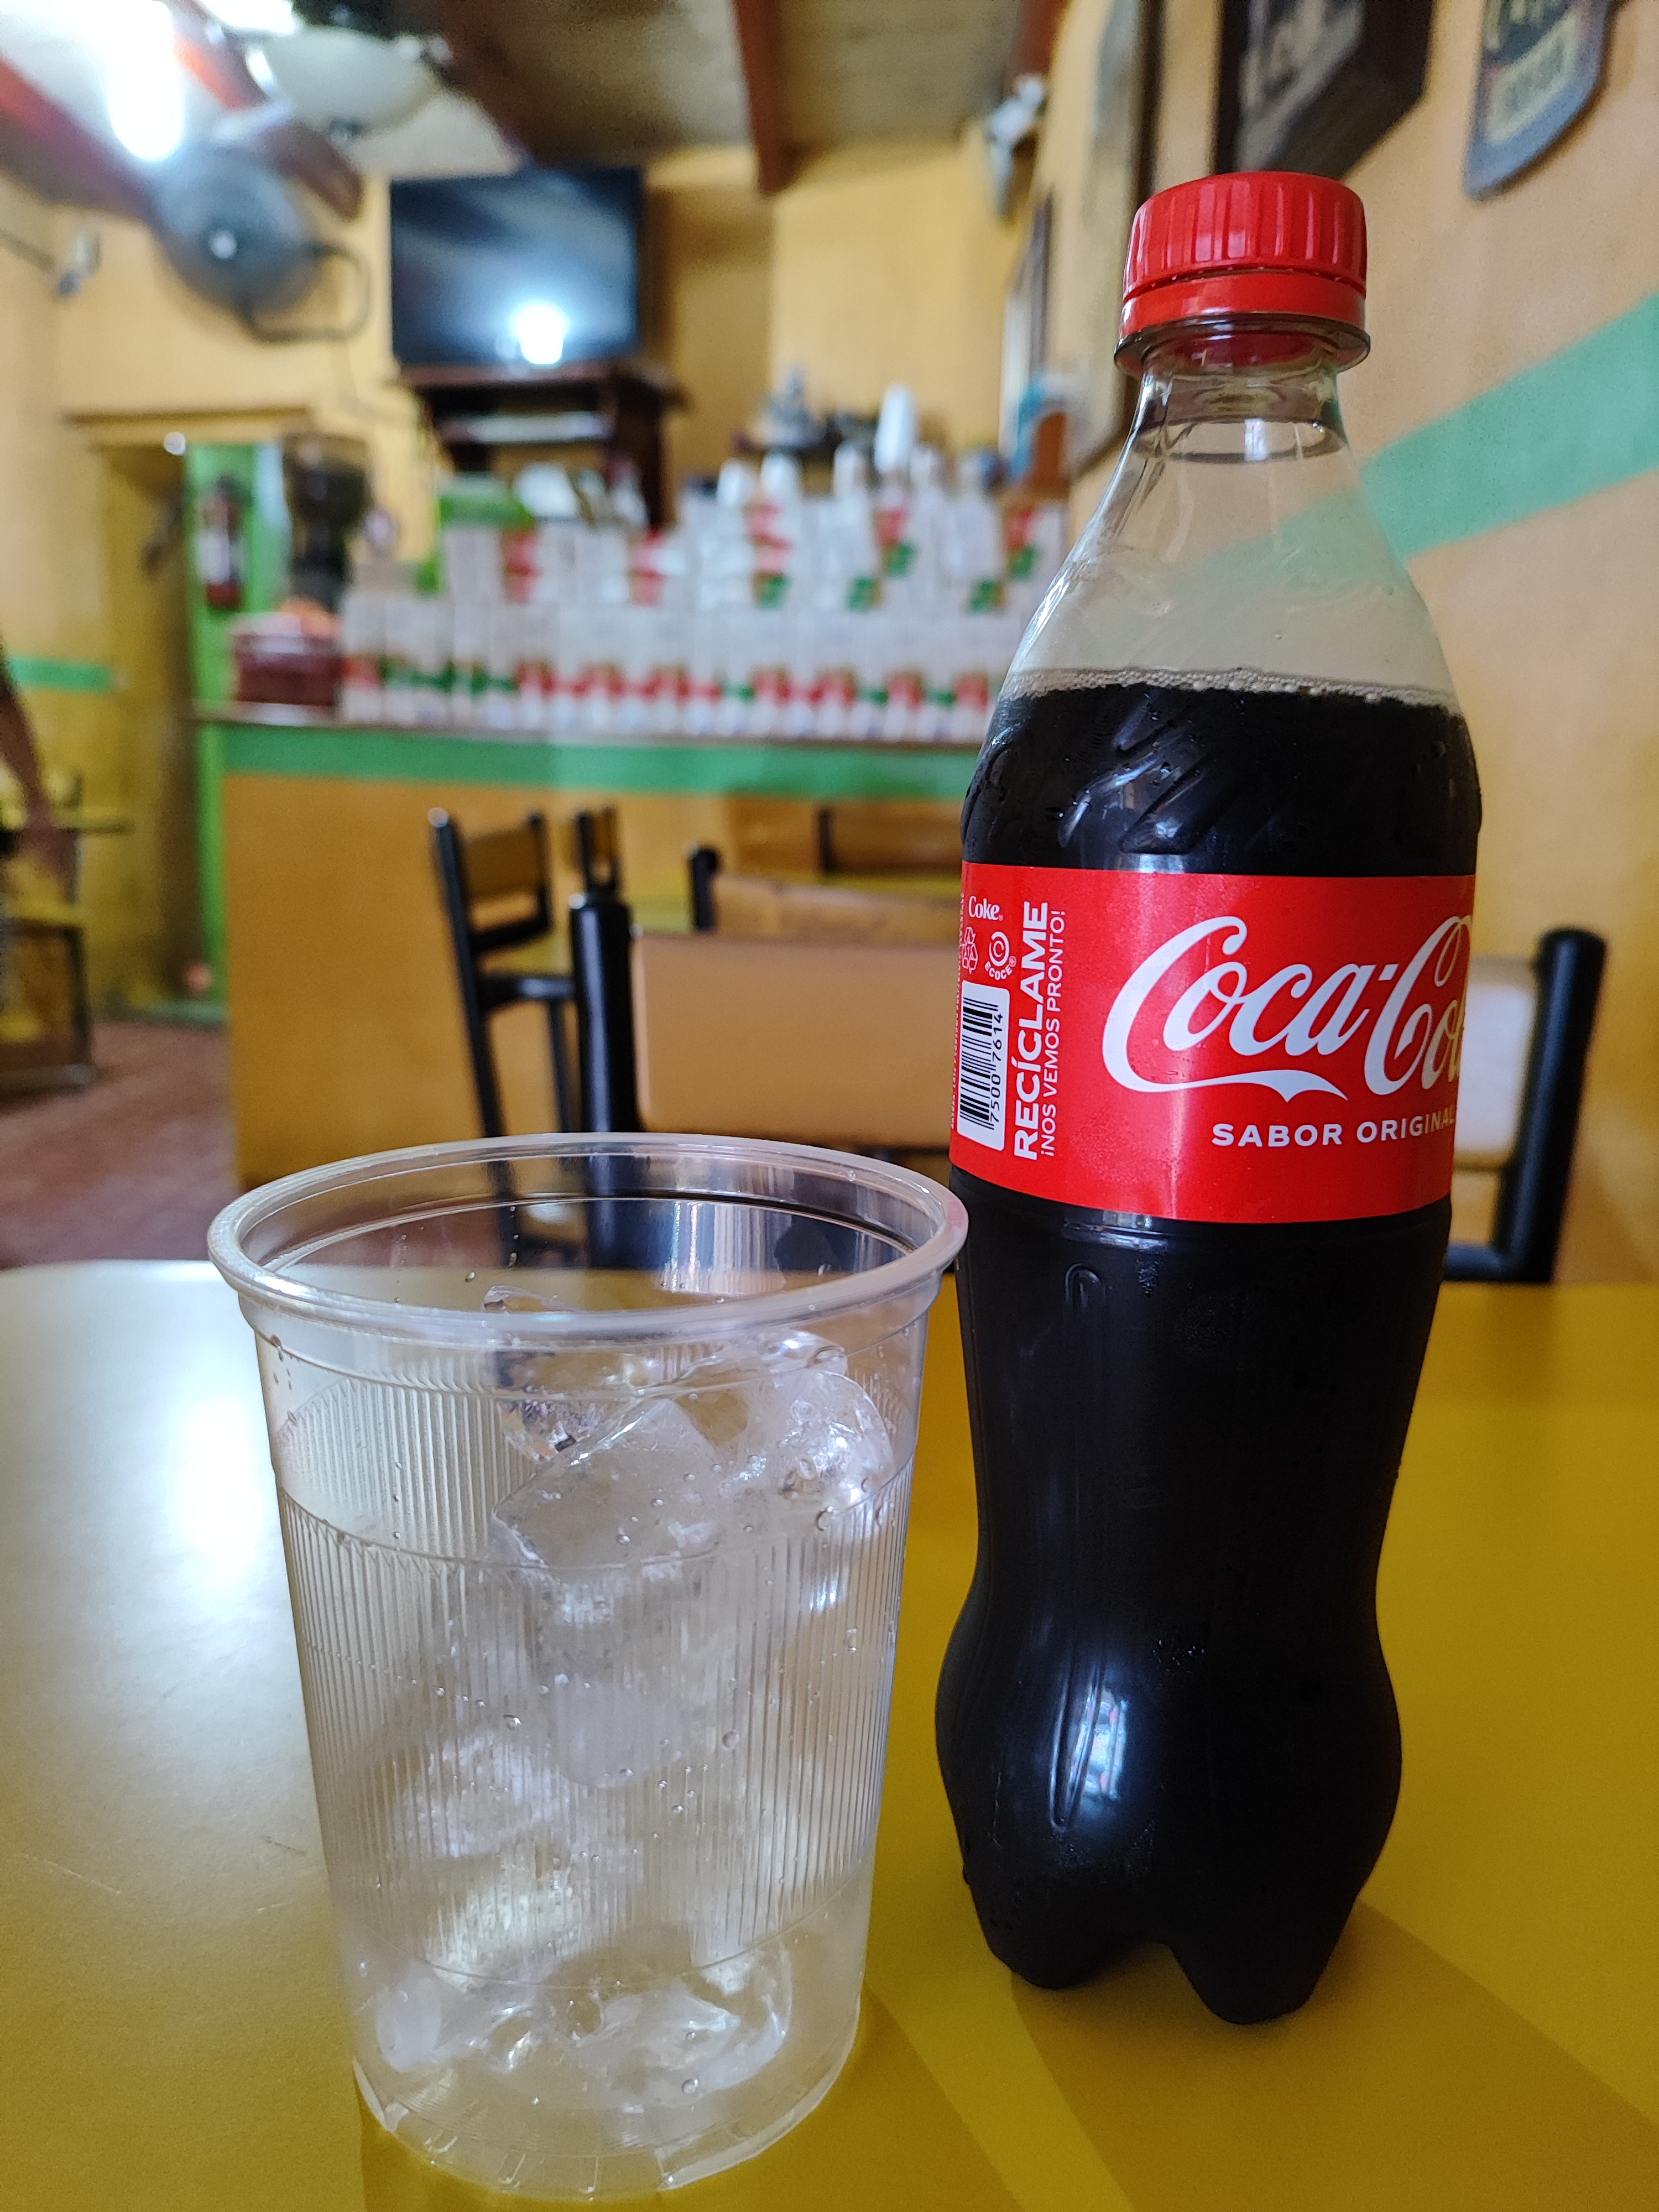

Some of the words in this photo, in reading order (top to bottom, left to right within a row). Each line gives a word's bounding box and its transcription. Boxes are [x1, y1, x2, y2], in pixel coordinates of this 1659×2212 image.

[968, 895, 1000, 921] Coke
[984, 961, 1013, 980] ECOCE
[1047, 910, 1066, 1012] PRONTO!
[1011, 901, 1048, 1161] RECÍCLAME
[1103, 914, 1472, 1102] Coca-Col
[1043, 1018, 1061, 1097] VEMOS
[1041, 1103, 1056, 1156] ¡NOS
[1212, 1123, 1343, 1147] SABOR
[1357, 1105, 1455, 1144] ORIGINAL
